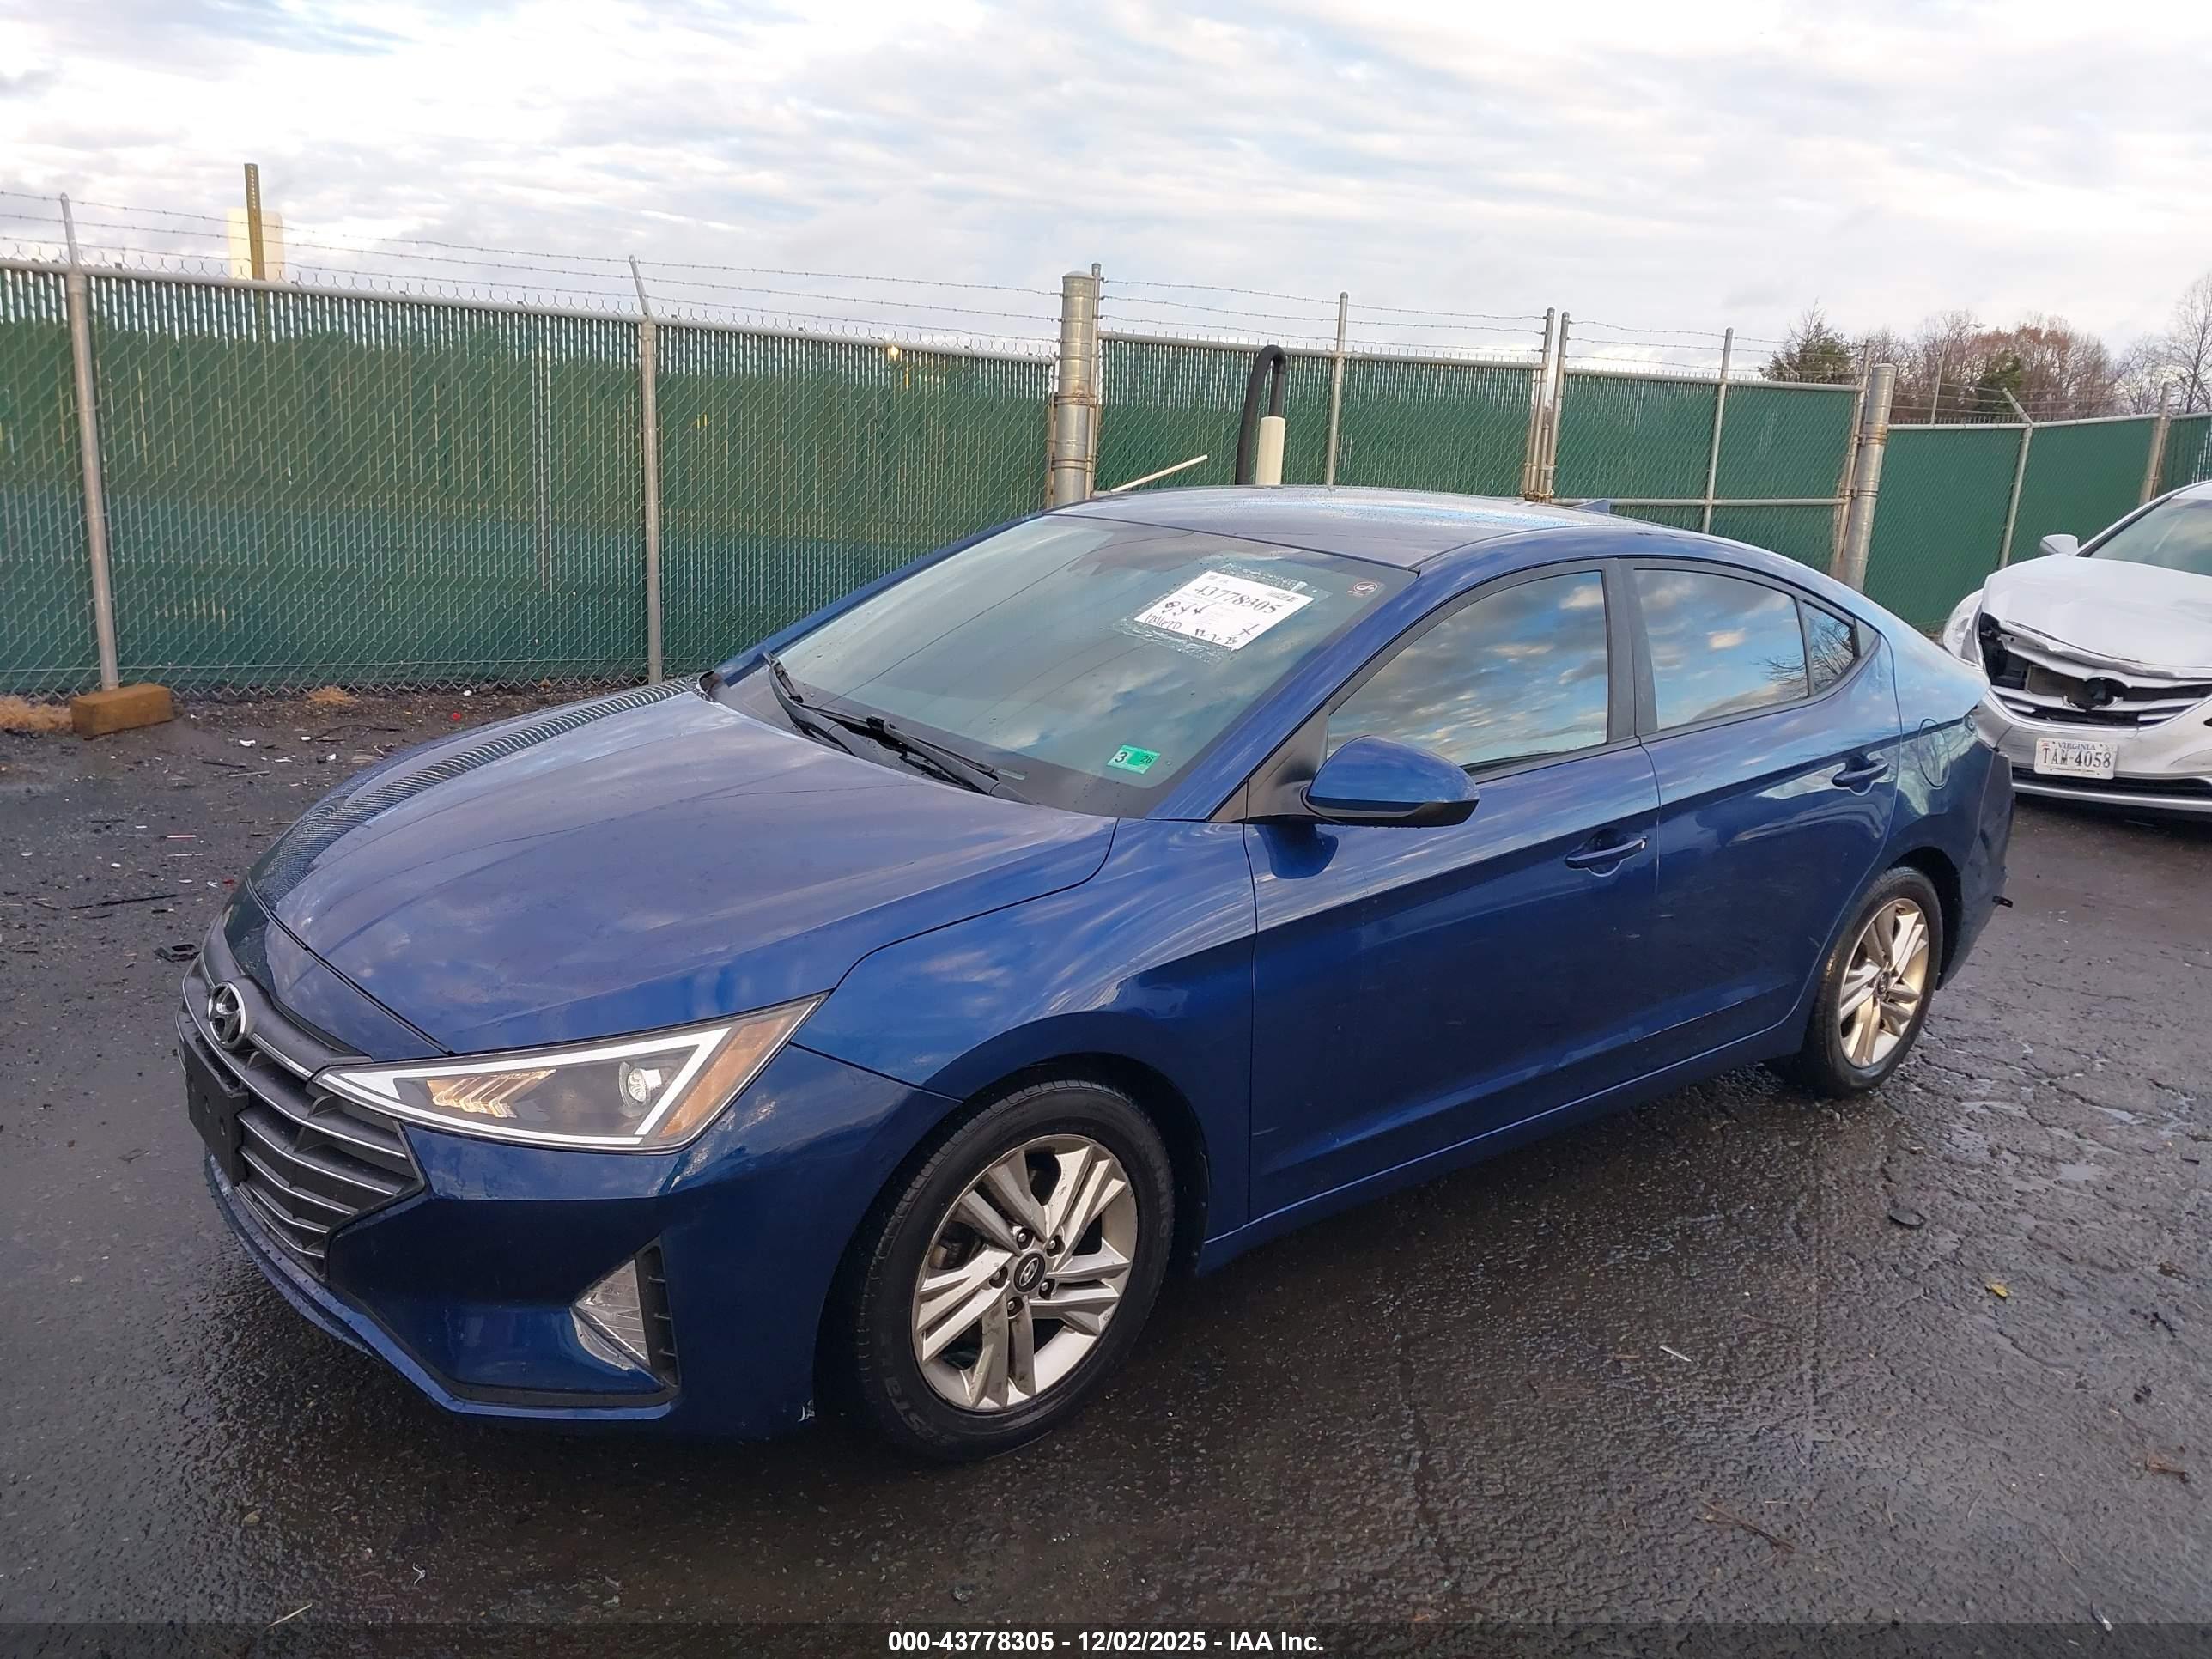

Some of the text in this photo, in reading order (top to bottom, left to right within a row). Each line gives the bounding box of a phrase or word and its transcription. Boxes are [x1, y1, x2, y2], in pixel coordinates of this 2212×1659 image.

[1195, 585, 1284, 614] 43778305
[2058, 742, 2096, 750] VIRGINIA
[1115, 751, 1128, 763] 3
